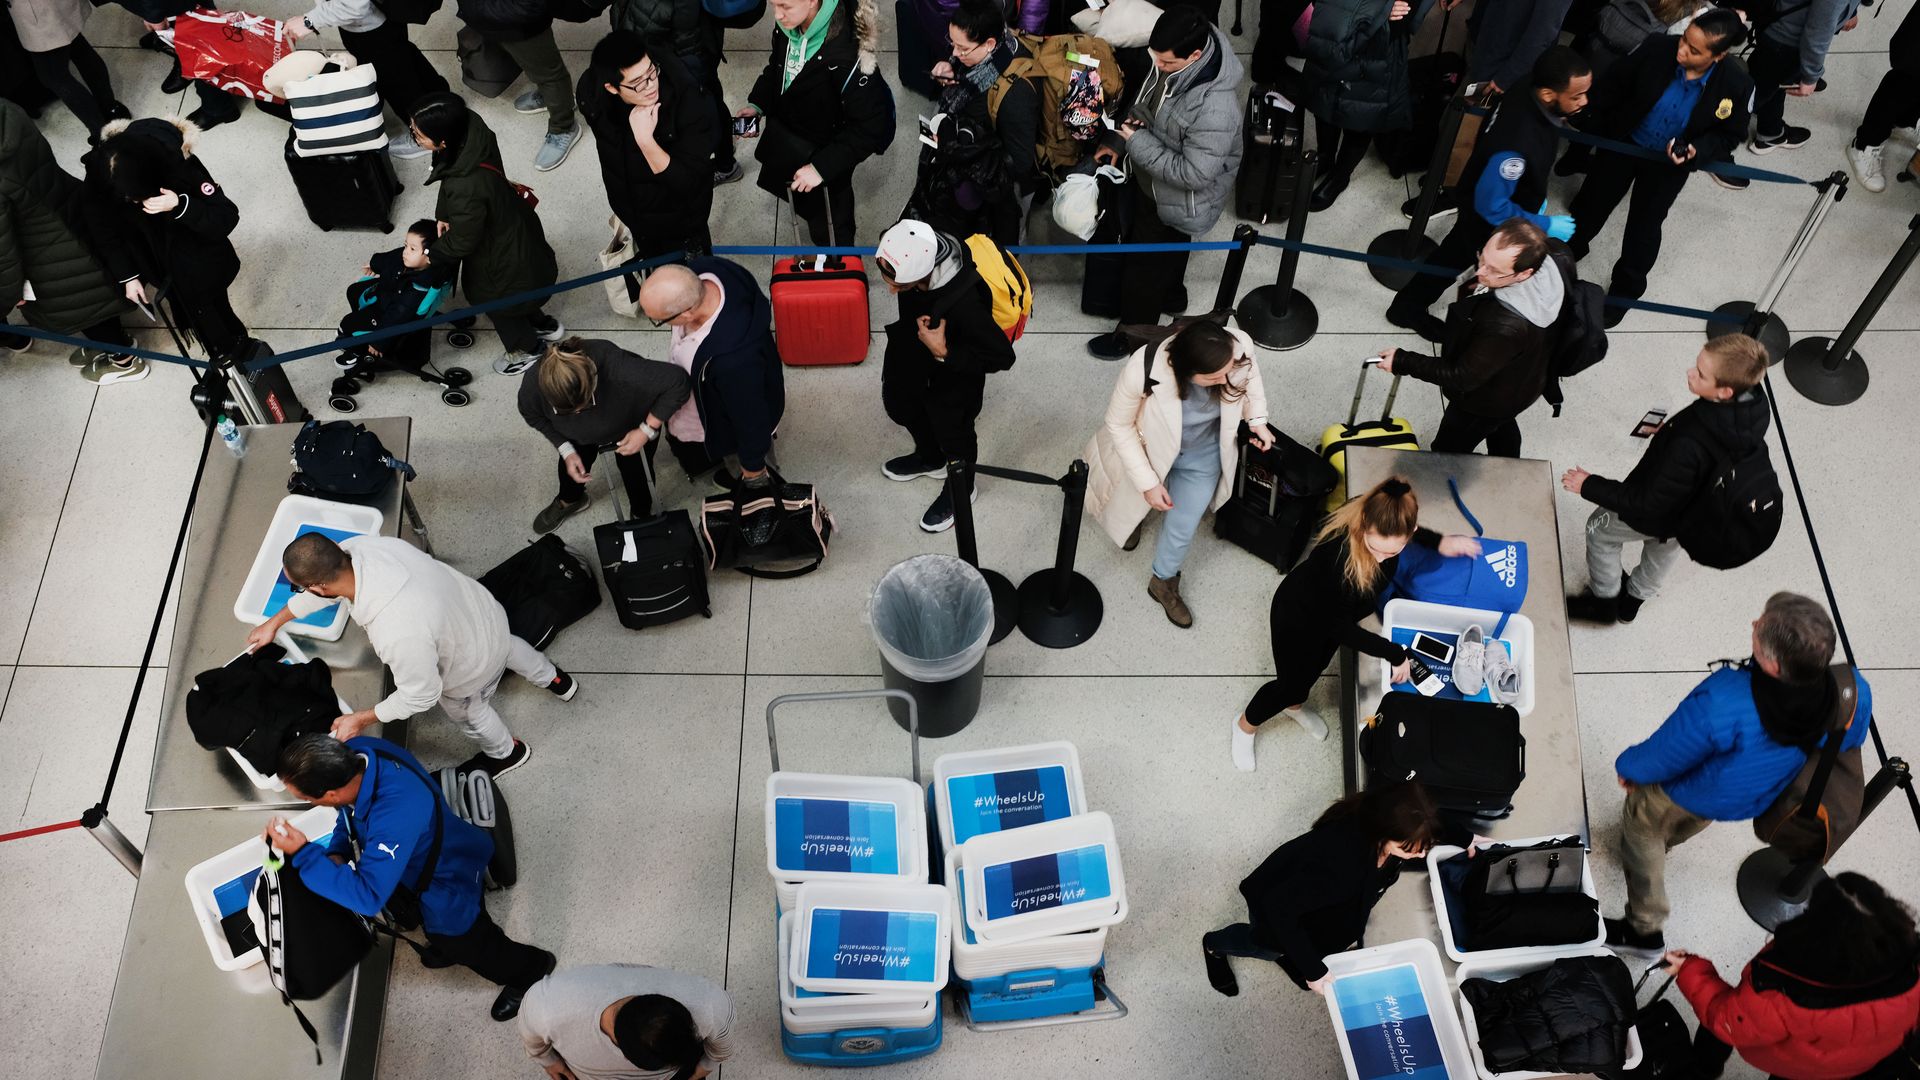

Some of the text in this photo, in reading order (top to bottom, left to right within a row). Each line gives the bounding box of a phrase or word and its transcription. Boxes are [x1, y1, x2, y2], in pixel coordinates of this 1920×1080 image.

[1505, 545, 1517, 587] adidas
[974, 790, 1045, 808] #WheelsUp
[993, 806, 1003, 814] the
[1004, 804, 1042, 813] conversation
[800, 842, 875, 857] #WheelsUp
[1011, 887, 1086, 909] #WheelsUp
[1015, 885, 1055, 896] conversation
[833, 951, 911, 967] #WheelsUp
[1375, 1002, 1383, 1016] Join
[1383, 1029, 1400, 1073] conversation
[1384, 994, 1416, 1075] #WheelsUp
